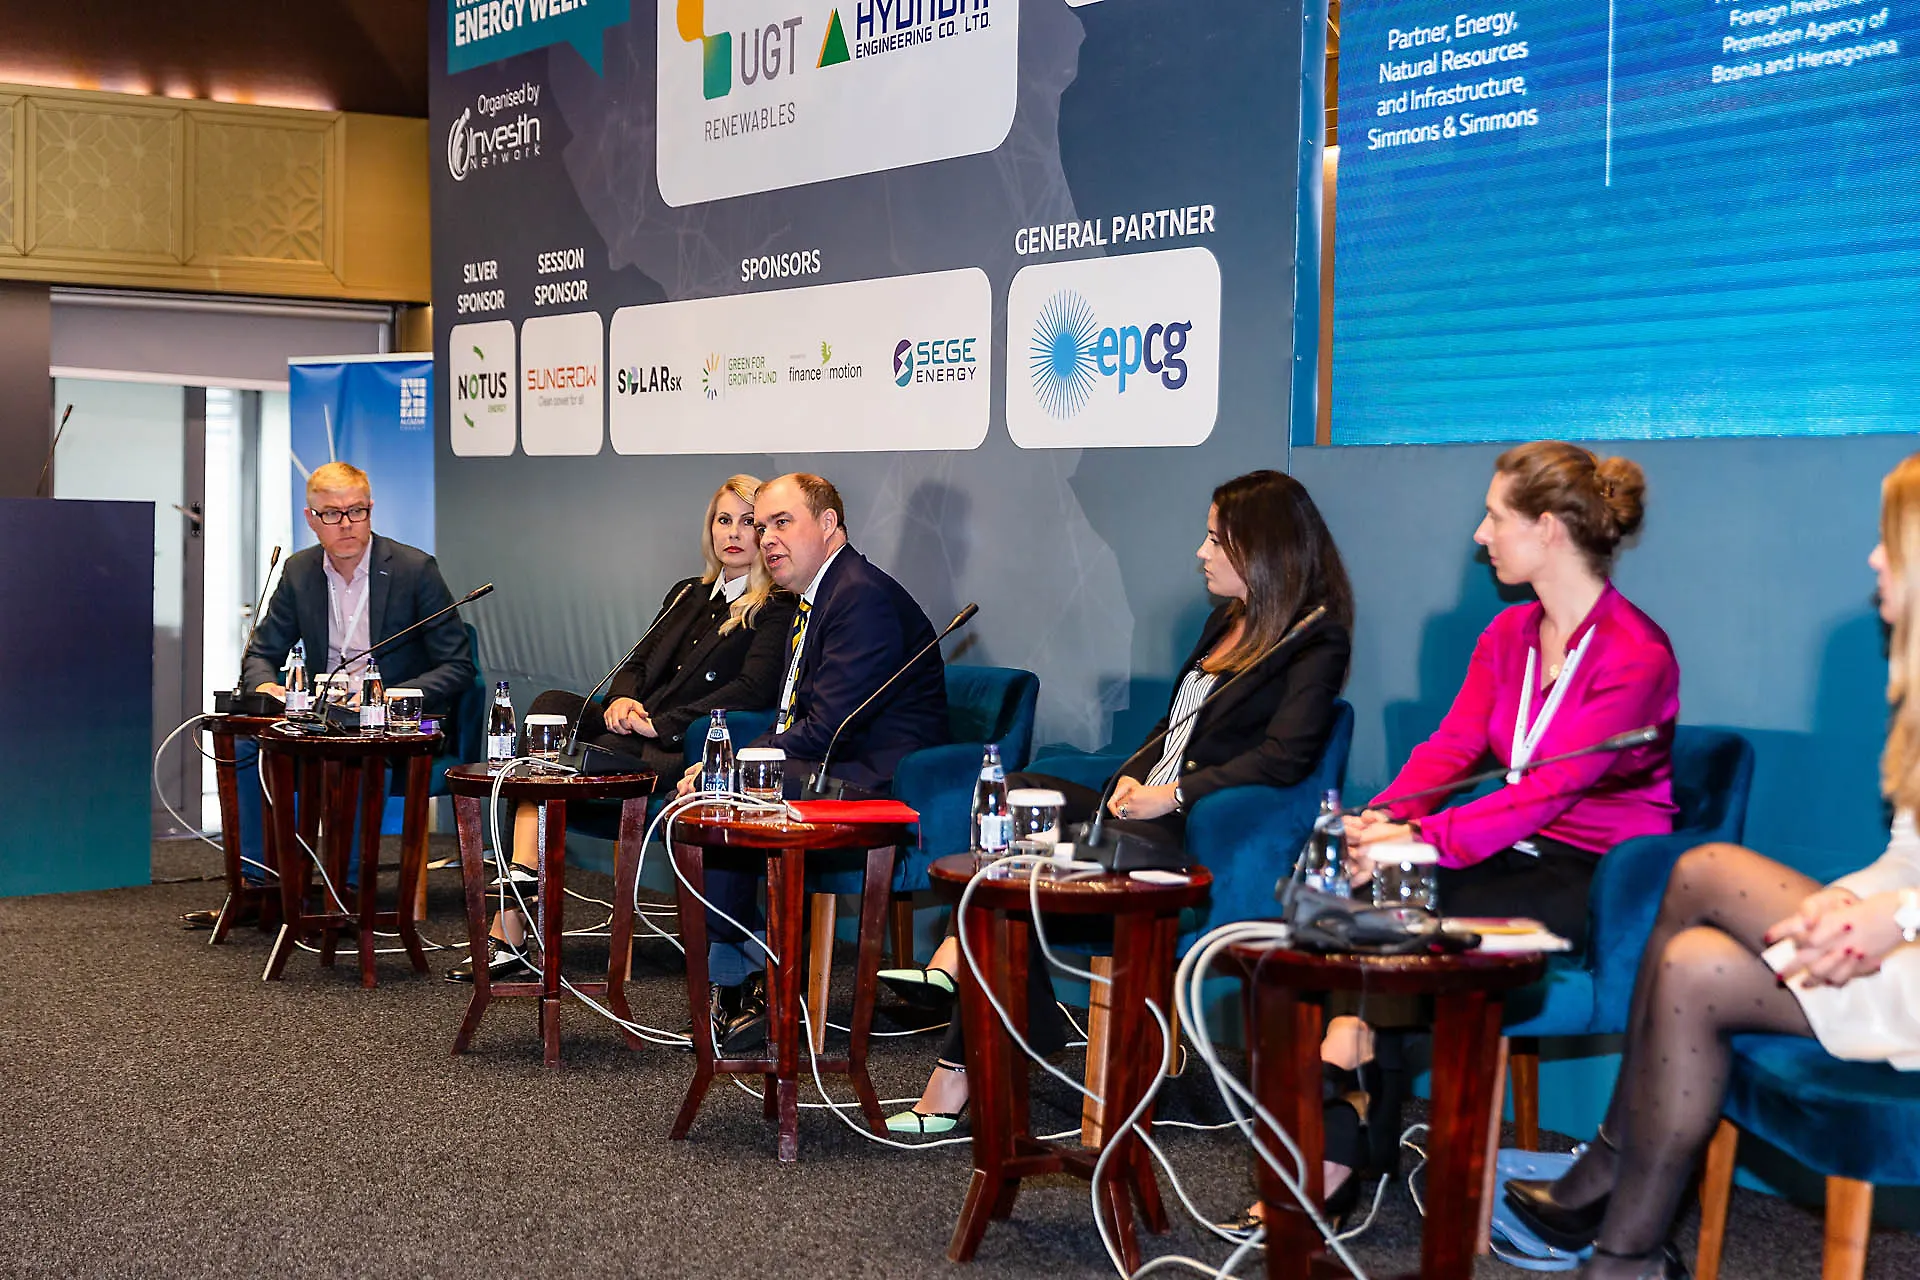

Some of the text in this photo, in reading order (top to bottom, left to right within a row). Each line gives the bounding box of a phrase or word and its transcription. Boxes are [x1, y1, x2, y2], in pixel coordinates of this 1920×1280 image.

[455, 0, 588, 47] ENERGY WE
[857, 0, 989, 40] HYUND
[1388, 11, 1519, 51] Partner, Energy,
[1723, 8, 1889, 54] Promotion Agency of
[1730, 5, 1788, 26] Foreign
[740, 16, 802, 86] UGT
[856, 26, 932, 59] ENGINEERING
[965, 12, 991, 32] LTD.
[1379, 41, 1528, 83] Natural Resources
[1712, 39, 1898, 83] Bosnia and Herzegovina
[478, 82, 539, 117] Organised by
[1377, 75, 1527, 117] and Infrastructure,
[705, 102, 795, 142] RENEWABLES
[1367, 107, 1538, 150] Simmons & Simmons
[1015, 204, 1216, 255] GENERAL PARTNER
[463, 259, 498, 284] SILVER
[537, 247, 585, 275] SESSION
[741, 249, 821, 282] SPONSORS
[457, 289, 506, 314] SPONSOR
[534, 279, 588, 306] SPONSOR
[728, 356, 766, 371] GREEN FOR
[916, 337, 976, 366] SEGE
[1097, 320, 1193, 394] epcg
[458, 372, 507, 400] NOTUS
[528, 365, 597, 391] SUNGROW
[728, 370, 777, 386] GROWTH FUND
[917, 366, 976, 384] ENERGY
[705, 782, 727, 791] SUZA
